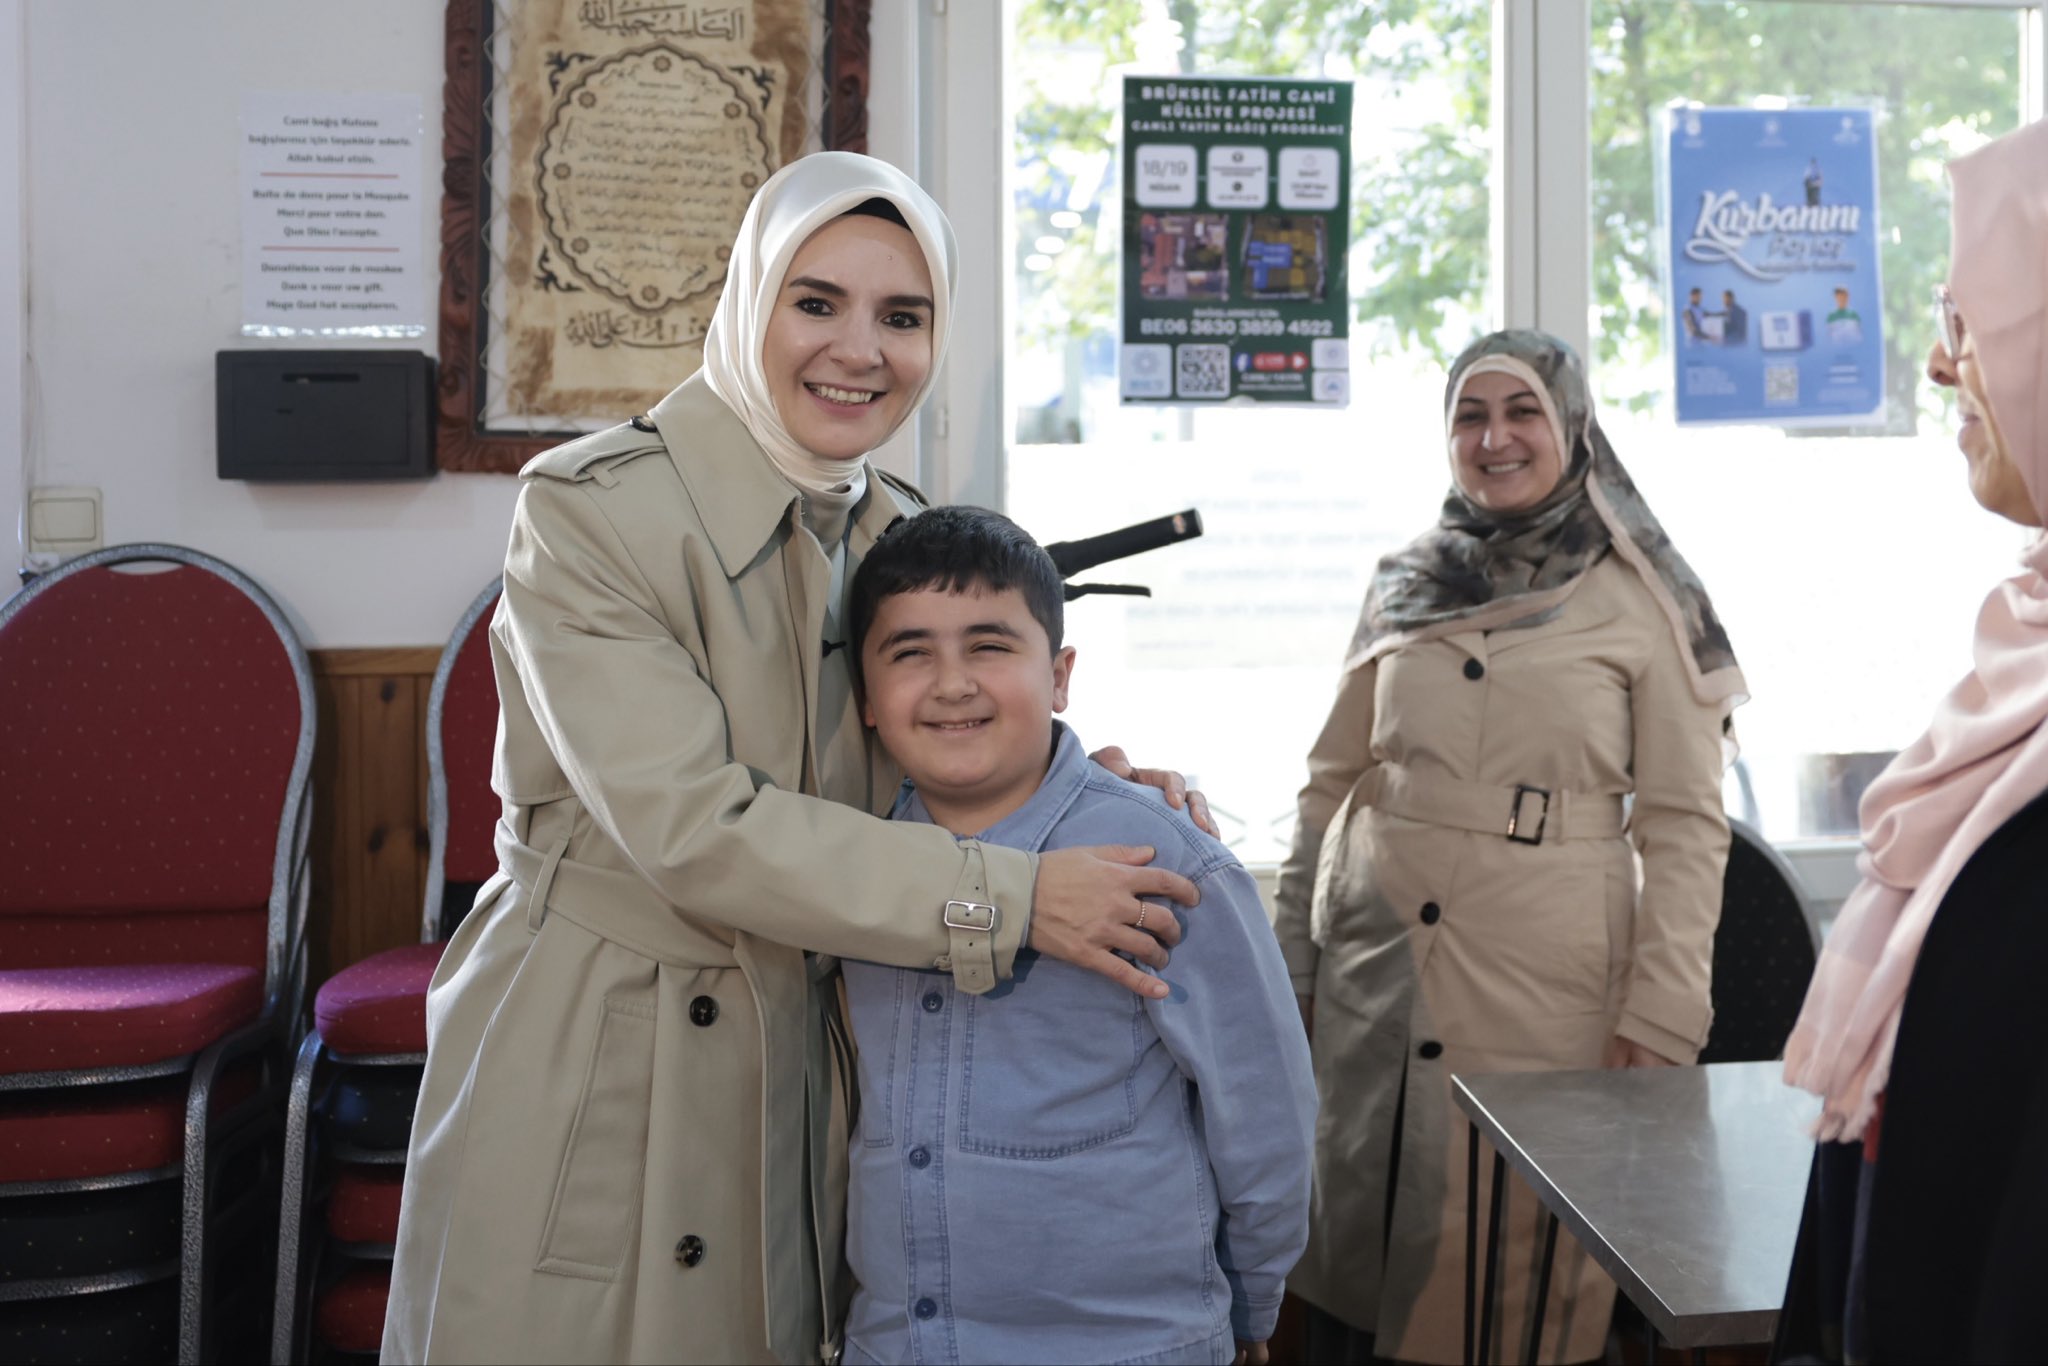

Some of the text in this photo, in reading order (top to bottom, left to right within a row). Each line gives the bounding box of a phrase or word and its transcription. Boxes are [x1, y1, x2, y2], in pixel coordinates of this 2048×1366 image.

[1141, 83, 1336, 104] BRÜKSEL FATİH CAMİ
[1160, 102, 1316, 121] KÜLLİYE PROJESİ
[282, 115, 309, 127] Cami
[286, 152, 313, 163] Allah
[1142, 159, 1188, 179] 18/19
[282, 190, 296, 200] de
[326, 192, 350, 203] pour
[276, 207, 305, 218] Merci
[307, 209, 331, 220] pour
[334, 209, 362, 218] votre
[283, 226, 305, 238] Que
[306, 226, 330, 236] Dieu
[323, 265, 346, 273] voor
[281, 281, 307, 291] Dank
[320, 283, 343, 291] voor
[266, 299, 294, 311] Moge
[296, 300, 317, 309] God
[319, 300, 338, 309] het
[1140, 317, 1334, 337] BE06 3630 3859 4522
